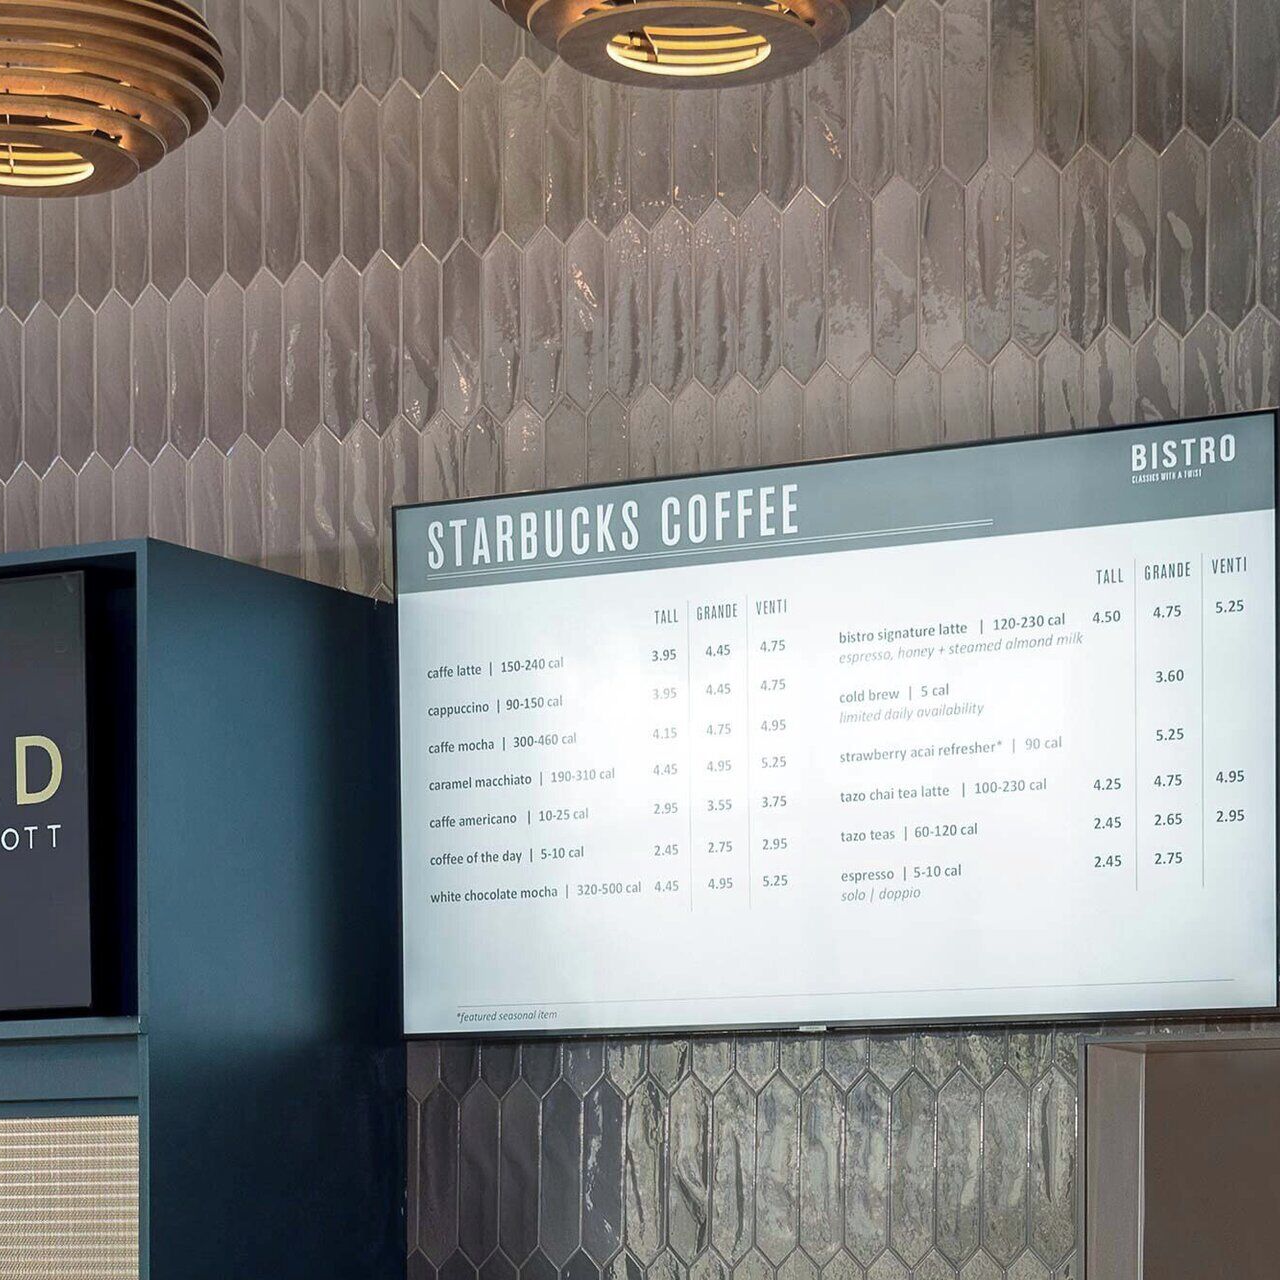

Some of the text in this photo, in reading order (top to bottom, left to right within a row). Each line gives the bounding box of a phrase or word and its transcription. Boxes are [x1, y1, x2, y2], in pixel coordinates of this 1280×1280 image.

[1132, 433, 1236, 472] BISTRO
[426, 483, 800, 570] STARBUCKS COFFEE
[1144, 561, 1191, 581] GRANDE
[1211, 556, 1247, 575] VENTI
[1096, 567, 1124, 585] TALL
[696, 603, 738, 621] GRANDE
[755, 598, 787, 616] VENTI
[1152, 604, 1182, 619] 4.75
[1215, 599, 1245, 614] 5.25
[654, 608, 679, 625] TALL
[1092, 609, 1121, 624] 4.50
[839, 612, 1065, 644] bistro signature latte 120-230 cal
[705, 644, 731, 657] 4.45
[759, 639, 786, 653] 4.75
[651, 648, 677, 662] 3.95
[426, 656, 564, 680] caffe latte 150-240 cal
[1155, 669, 1185, 684] 3.60
[760, 678, 786, 692] 4.75
[839, 682, 949, 704] cold brew 5 cal
[427, 694, 563, 719] cappuccino 90-150 cal
[760, 718, 787, 732] 4.95
[1156, 727, 1185, 742] 5.25
[428, 731, 577, 754] caffe mocha 300-460 cal
[839, 748, 907, 764] strawberry
[910, 744, 935, 759] acai
[1024, 737, 1041, 751] 90
[1044, 735, 1063, 750] cal
[761, 755, 787, 769] 5.25
[428, 767, 615, 791] caramel macchiato 190-310 cal
[1093, 777, 1122, 791] 4.25
[1153, 773, 1183, 787] 4.75
[1215, 769, 1245, 784] 4.95
[840, 777, 1047, 803] tazo chai tea latte 100-230 cal
[653, 802, 679, 815] 2.95
[707, 798, 733, 812] 3.55
[762, 795, 787, 809] 3.75
[429, 807, 589, 829] caffe americano 10-25 cal
[1094, 816, 1122, 830] 2.45
[1154, 812, 1183, 826] 2.65
[1216, 809, 1245, 823] 2.95
[840, 822, 978, 843] tazo teas 60-120 cal
[654, 843, 679, 857] 2.45
[708, 840, 733, 854] 2.75
[762, 837, 788, 851] 2.95
[429, 845, 584, 866] coffee of the day 5-10 cal
[1094, 854, 1122, 868] 2.45
[1154, 851, 1183, 865] 2.75
[762, 874, 789, 888] 5.25
[840, 863, 962, 884] espresso 5-10 cal
[654, 879, 680, 893] 4.45
[707, 876, 734, 890] 4.95
[430, 880, 642, 904] white chocolate mocha 320-500 cal
